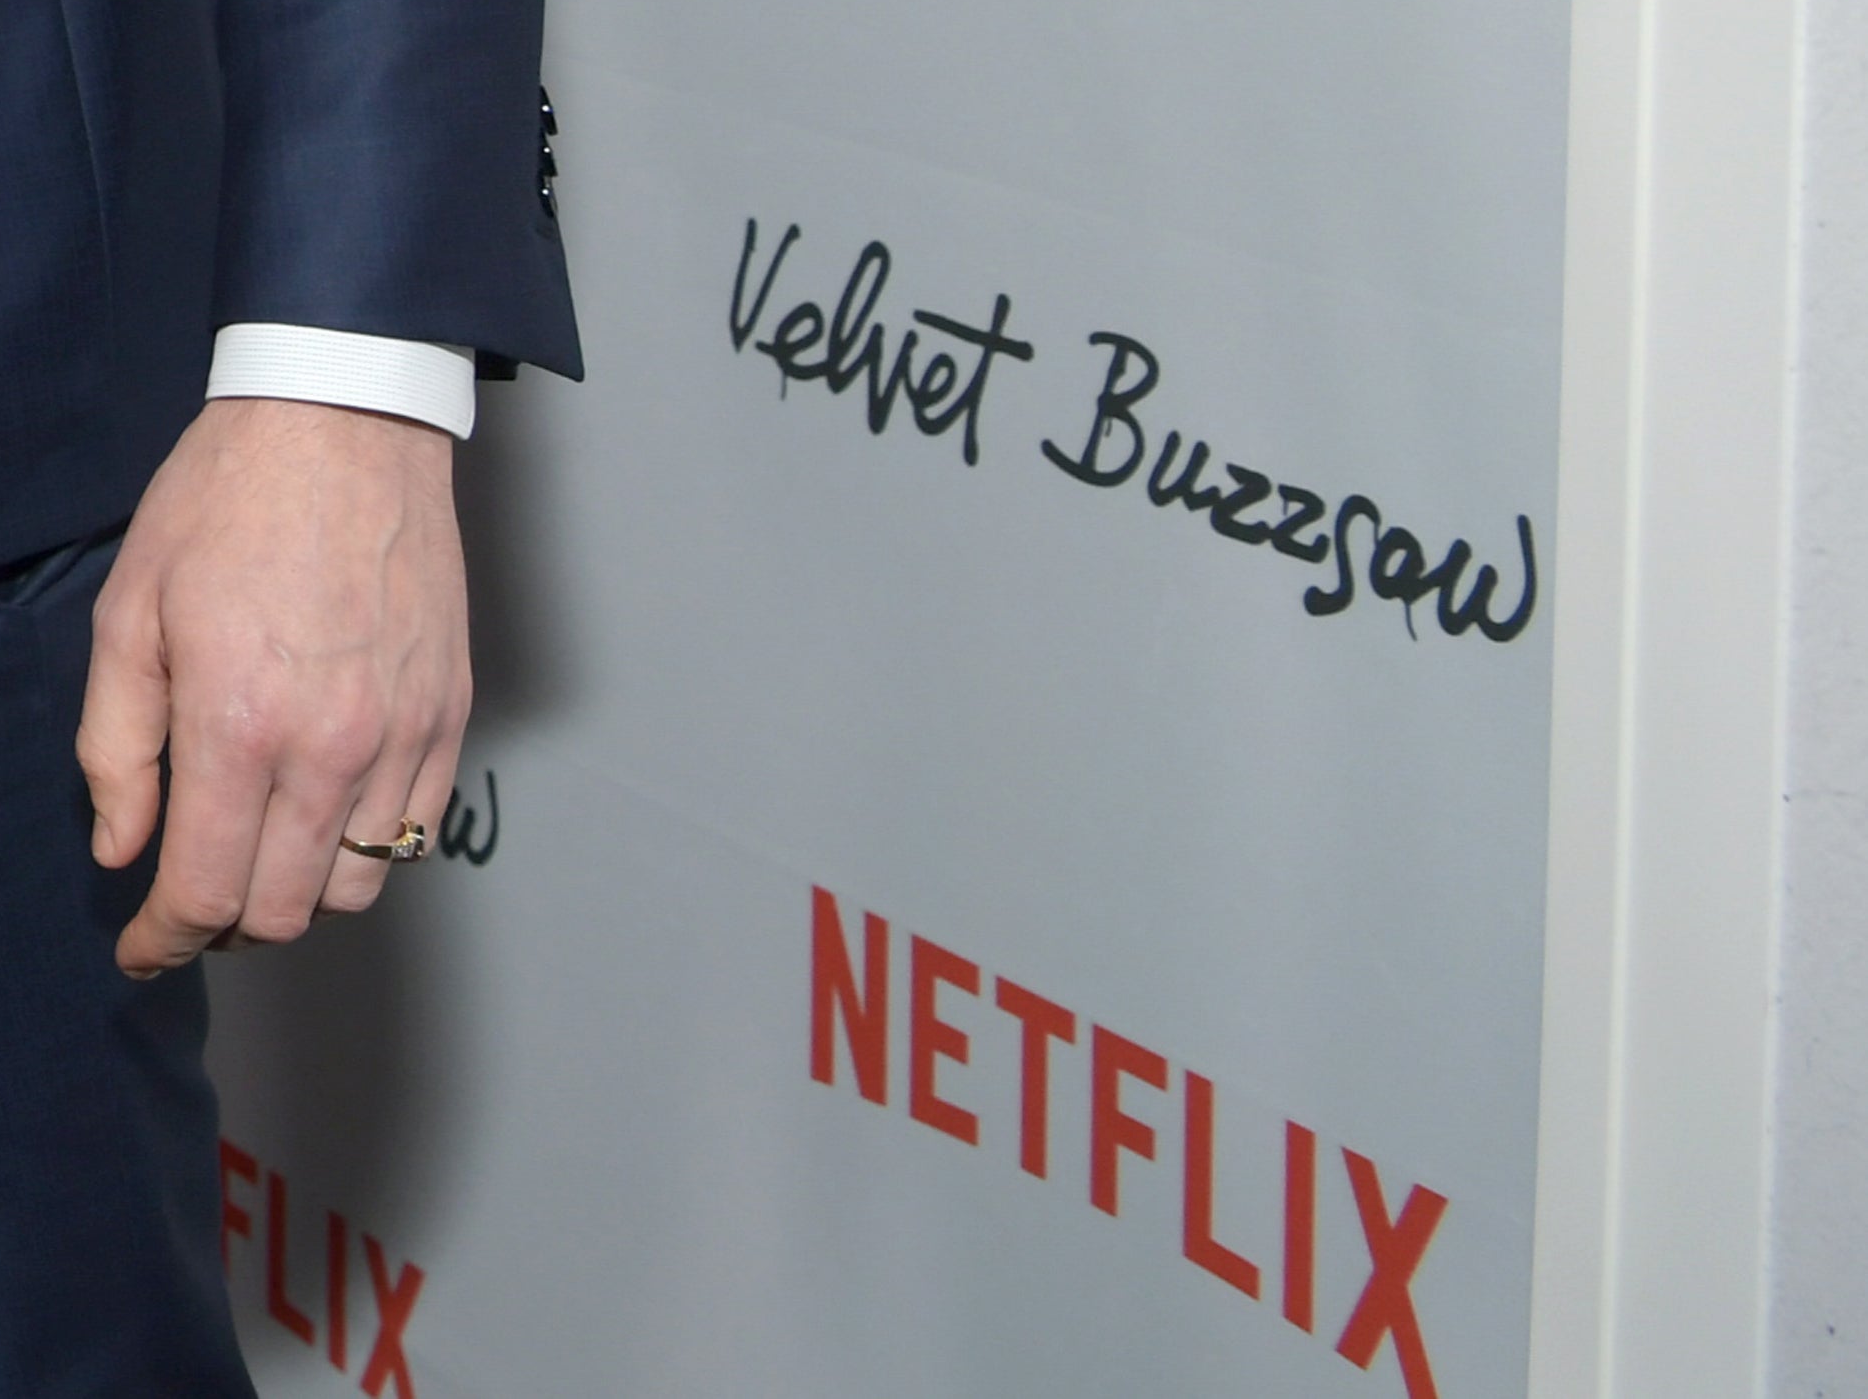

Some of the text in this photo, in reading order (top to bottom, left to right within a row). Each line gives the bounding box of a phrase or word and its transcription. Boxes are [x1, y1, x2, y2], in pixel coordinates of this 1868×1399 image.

[727, 216, 1538, 644] Velvet Buzzsaw
[219, 1136, 426, 1399] FLIX
[810, 884, 1449, 1399] NETFLIX
